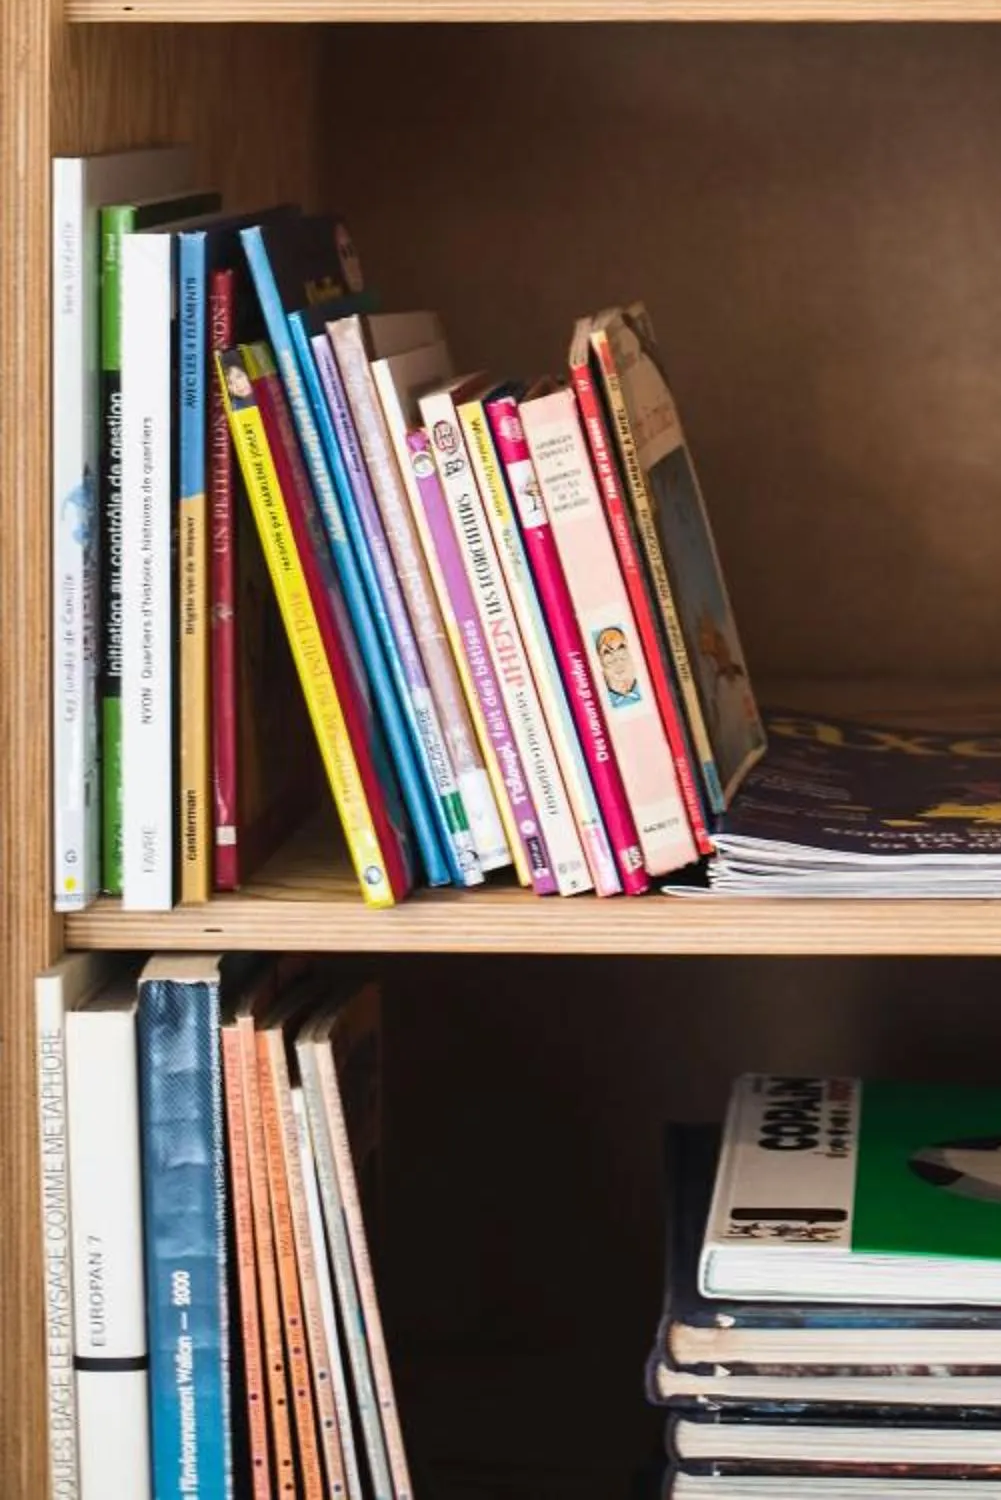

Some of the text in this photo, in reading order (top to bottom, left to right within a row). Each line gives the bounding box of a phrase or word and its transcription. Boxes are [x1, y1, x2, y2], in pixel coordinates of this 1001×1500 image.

[185, 352, 198, 409] AVEC LES
[140, 416, 155, 475] quartiers
[242, 421, 265, 459] JOBERT
[139, 477, 153, 493] de
[212, 413, 230, 554] UN PETIT LION
[105, 390, 123, 678] Initiation au contrôle de gestion
[139, 495, 153, 552] histoires
[266, 508, 285, 529] par
[184, 560, 196, 574] de
[61, 572, 75, 626] Camille
[184, 598, 199, 636] Brigitte
[61, 630, 75, 647] de
[140, 621, 154, 680] Quartiers
[301, 636, 328, 677] petit
[462, 619, 489, 677] bêtises
[488, 616, 524, 689] JHEN
[140, 687, 153, 726] NYON
[480, 680, 498, 708] des
[489, 712, 512, 739] fait
[590, 738, 609, 762] Des
[142, 826, 156, 874] FAVRE
[184, 788, 198, 862] casterman
[39, 1028, 66, 1155] METAPHORE
[42, 1161, 67, 1241] COMME
[45, 1246, 70, 1339] PAYSAGE
[87, 1234, 107, 1349] EUROPAN 7
[49, 1342, 71, 1370] LE
[170, 1270, 199, 1492] l'Environnement Wallon 2000
[51, 1374, 73, 1431] BAGE
